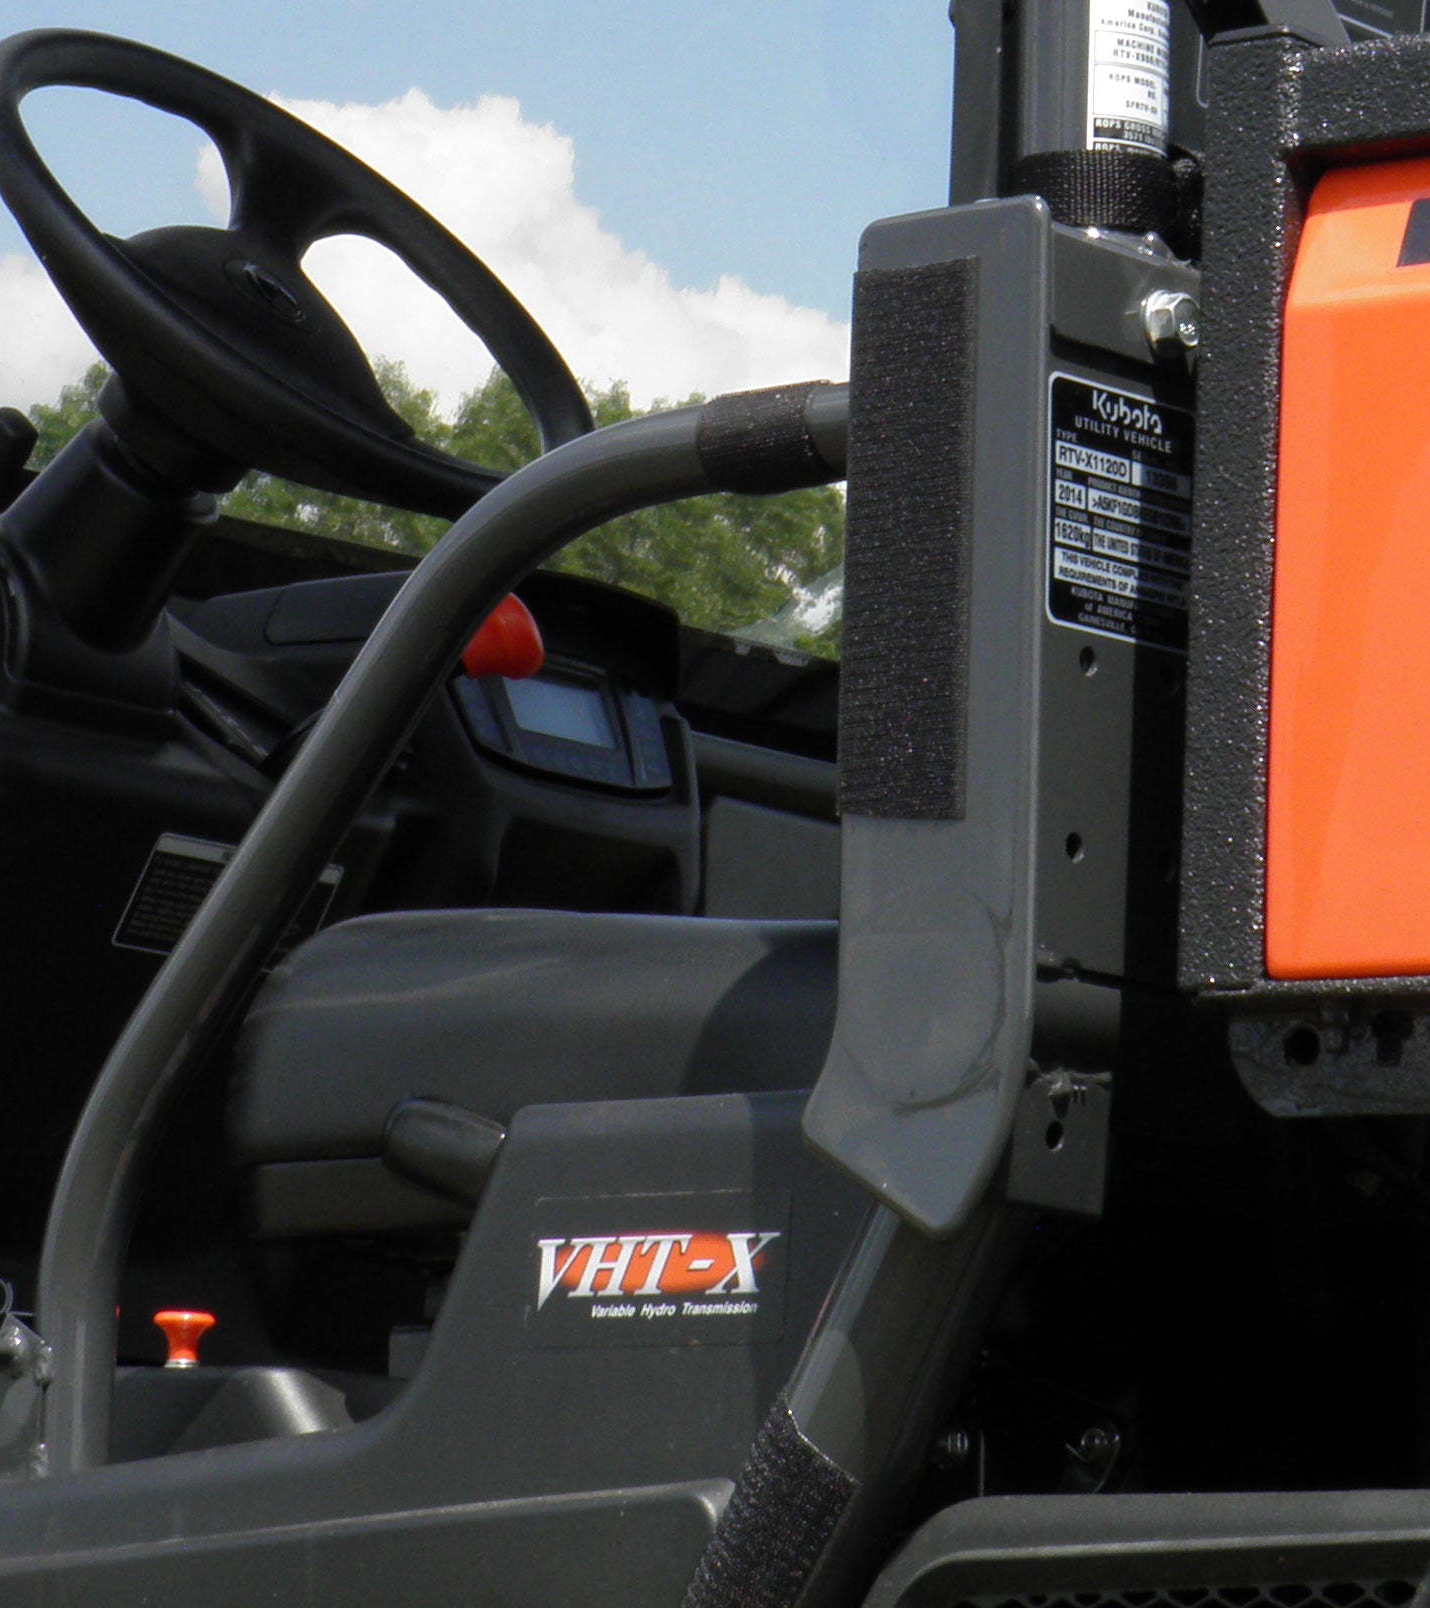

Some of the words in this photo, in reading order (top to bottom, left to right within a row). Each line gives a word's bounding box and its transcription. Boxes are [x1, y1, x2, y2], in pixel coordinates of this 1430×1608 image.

[1095, 118, 1121, 130] ROPS
[1092, 389, 1163, 435] Kubota
[1074, 414, 1120, 439] UTILITY
[1122, 428, 1172, 454] VEHICLE
[1059, 444, 1127, 478] RTV-X1120D
[1059, 484, 1083, 506] 2014
[537, 1232, 781, 1312] VHT-X
[591, 1304, 636, 1318] Variable
[640, 1303, 677, 1320] Hydro
[682, 1301, 759, 1316] Transmission
